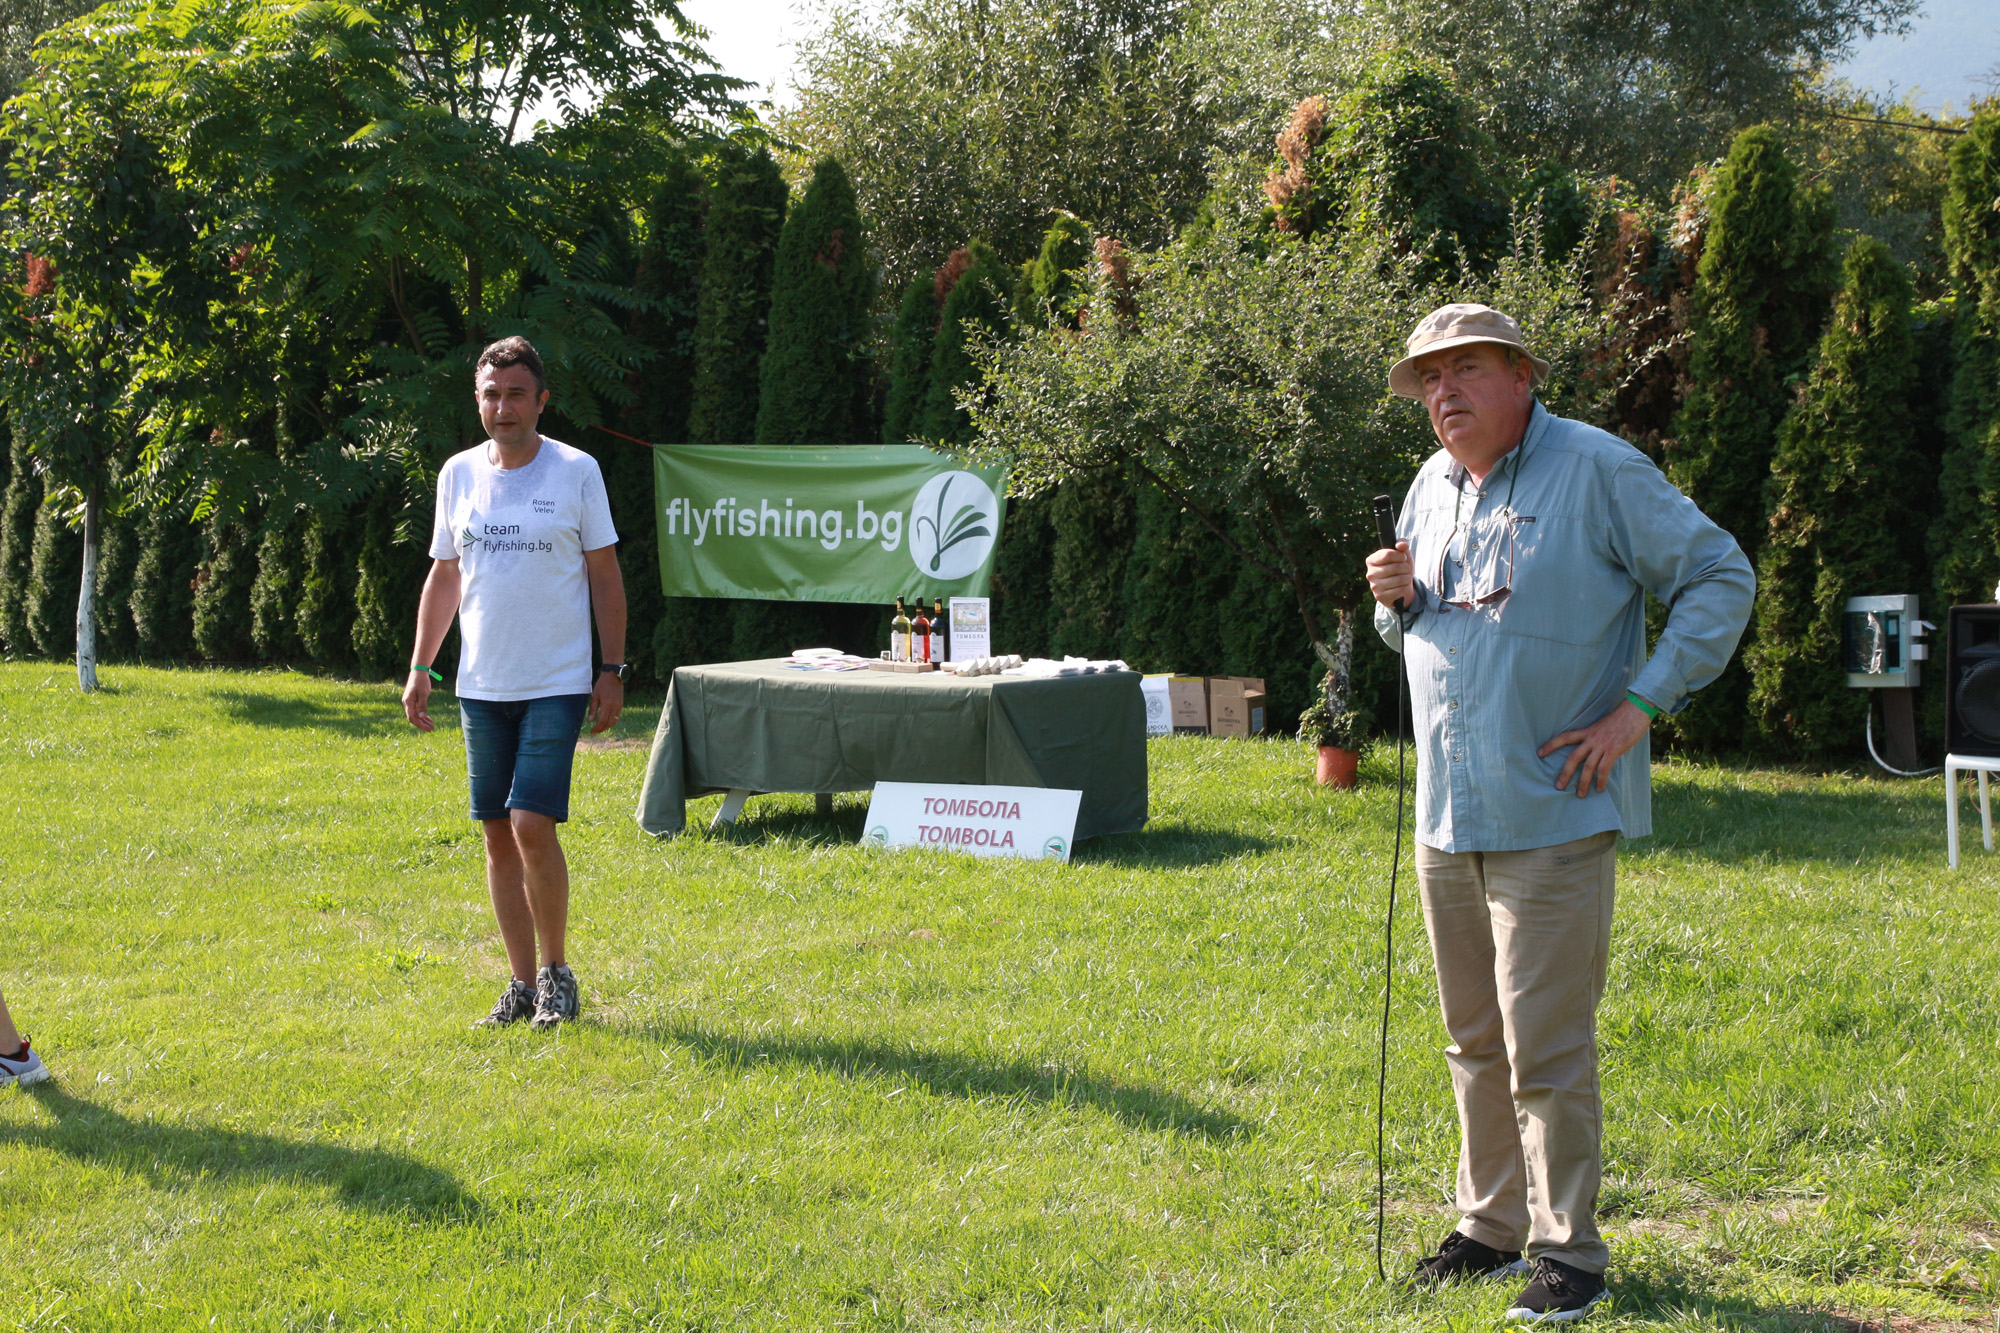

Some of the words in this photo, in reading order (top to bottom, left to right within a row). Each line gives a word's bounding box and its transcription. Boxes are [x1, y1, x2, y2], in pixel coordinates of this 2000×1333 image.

[484, 524, 520, 535] team
[666, 498, 903, 551] flyfishing.bg
[483, 540, 552, 553] flyfishing.bg
[923, 797, 1021, 819] ТОМБОЛА
[918, 825, 1014, 847] TOMBOLA
